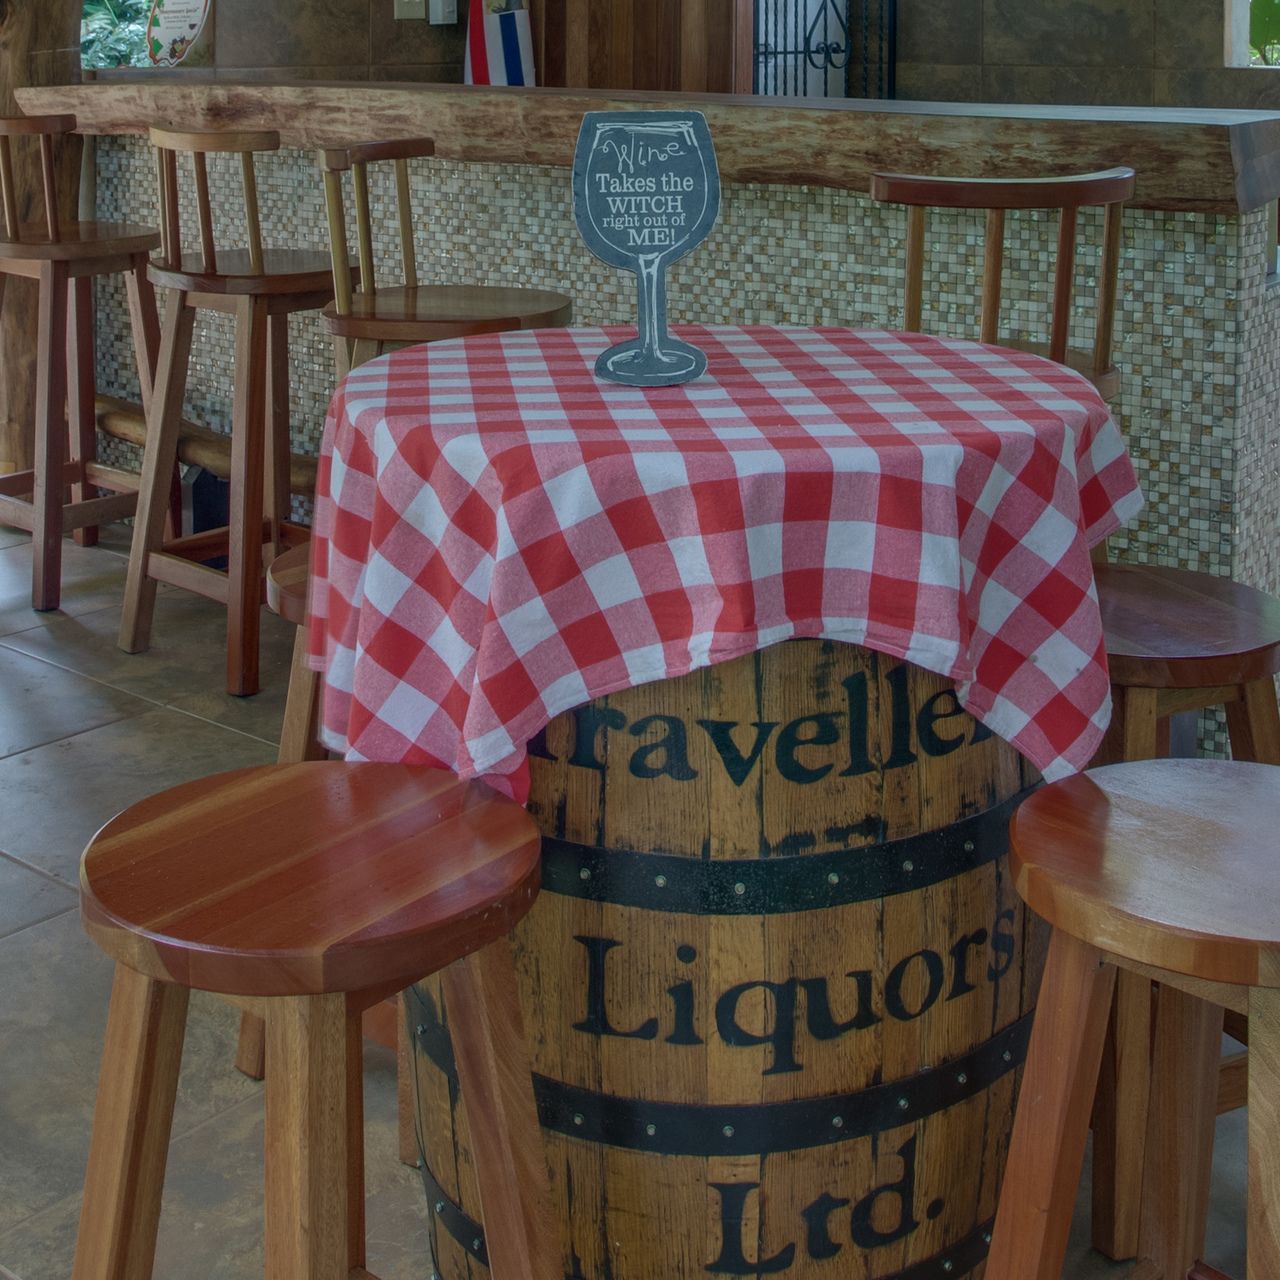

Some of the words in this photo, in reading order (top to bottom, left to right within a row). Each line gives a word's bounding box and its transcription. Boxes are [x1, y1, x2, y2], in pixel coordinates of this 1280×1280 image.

[597, 132, 687, 174] Wine
[595, 173, 657, 194] Takes
[660, 173, 694, 193] the
[606, 195, 684, 215] WITCH
[602, 214, 640, 231] right
[643, 216, 669, 227] out
[671, 213, 687, 227] of
[627, 227, 677, 247] ME!
[570, 906, 1017, 1076] Liquors
[704, 1132, 945, 1275] Ltd.
